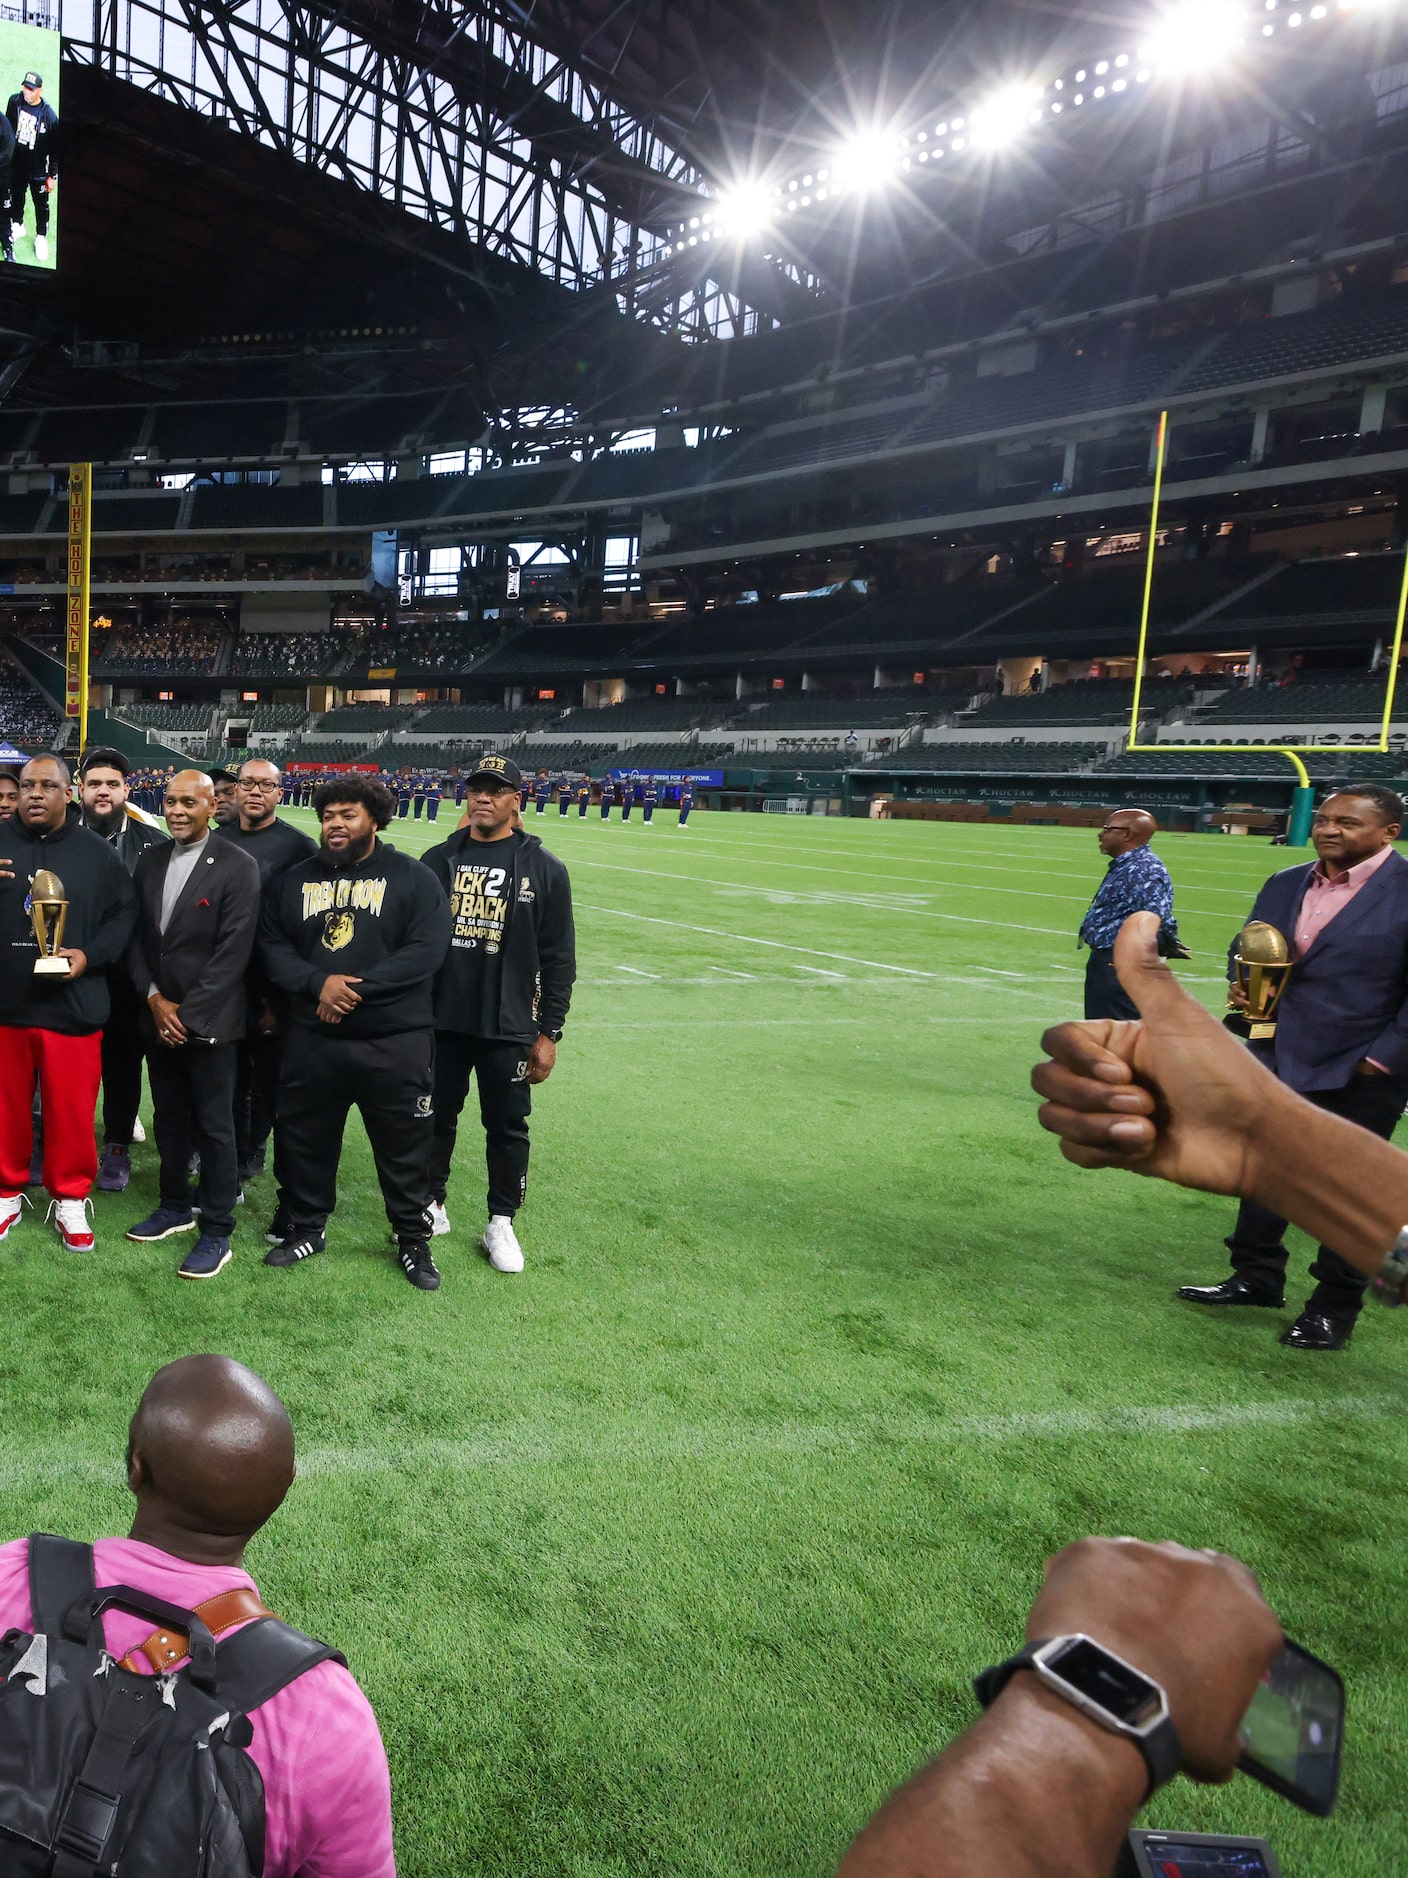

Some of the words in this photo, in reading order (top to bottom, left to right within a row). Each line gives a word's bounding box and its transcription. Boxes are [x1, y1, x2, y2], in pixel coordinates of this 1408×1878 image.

[71, 493, 81, 535] THE
[70, 545, 81, 587] HOT
[69, 597, 80, 652] ZONE
[562, 770, 586, 778] Williams
[917, 787, 967, 796] CHOCTAW
[981, 788, 1035, 797] CHOCTAW
[1051, 788, 1110, 798] CHOCTAW
[1127, 790, 1191, 800] CHOCTAW
[460, 864, 472, 872] OAK
[472, 865, 490, 874] CLIFF
[484, 867, 507, 897] 2
[460, 894, 508, 922] BACK
[454, 923, 503, 942] CHAMPIONS
[452, 937, 472, 947] DALLAS
